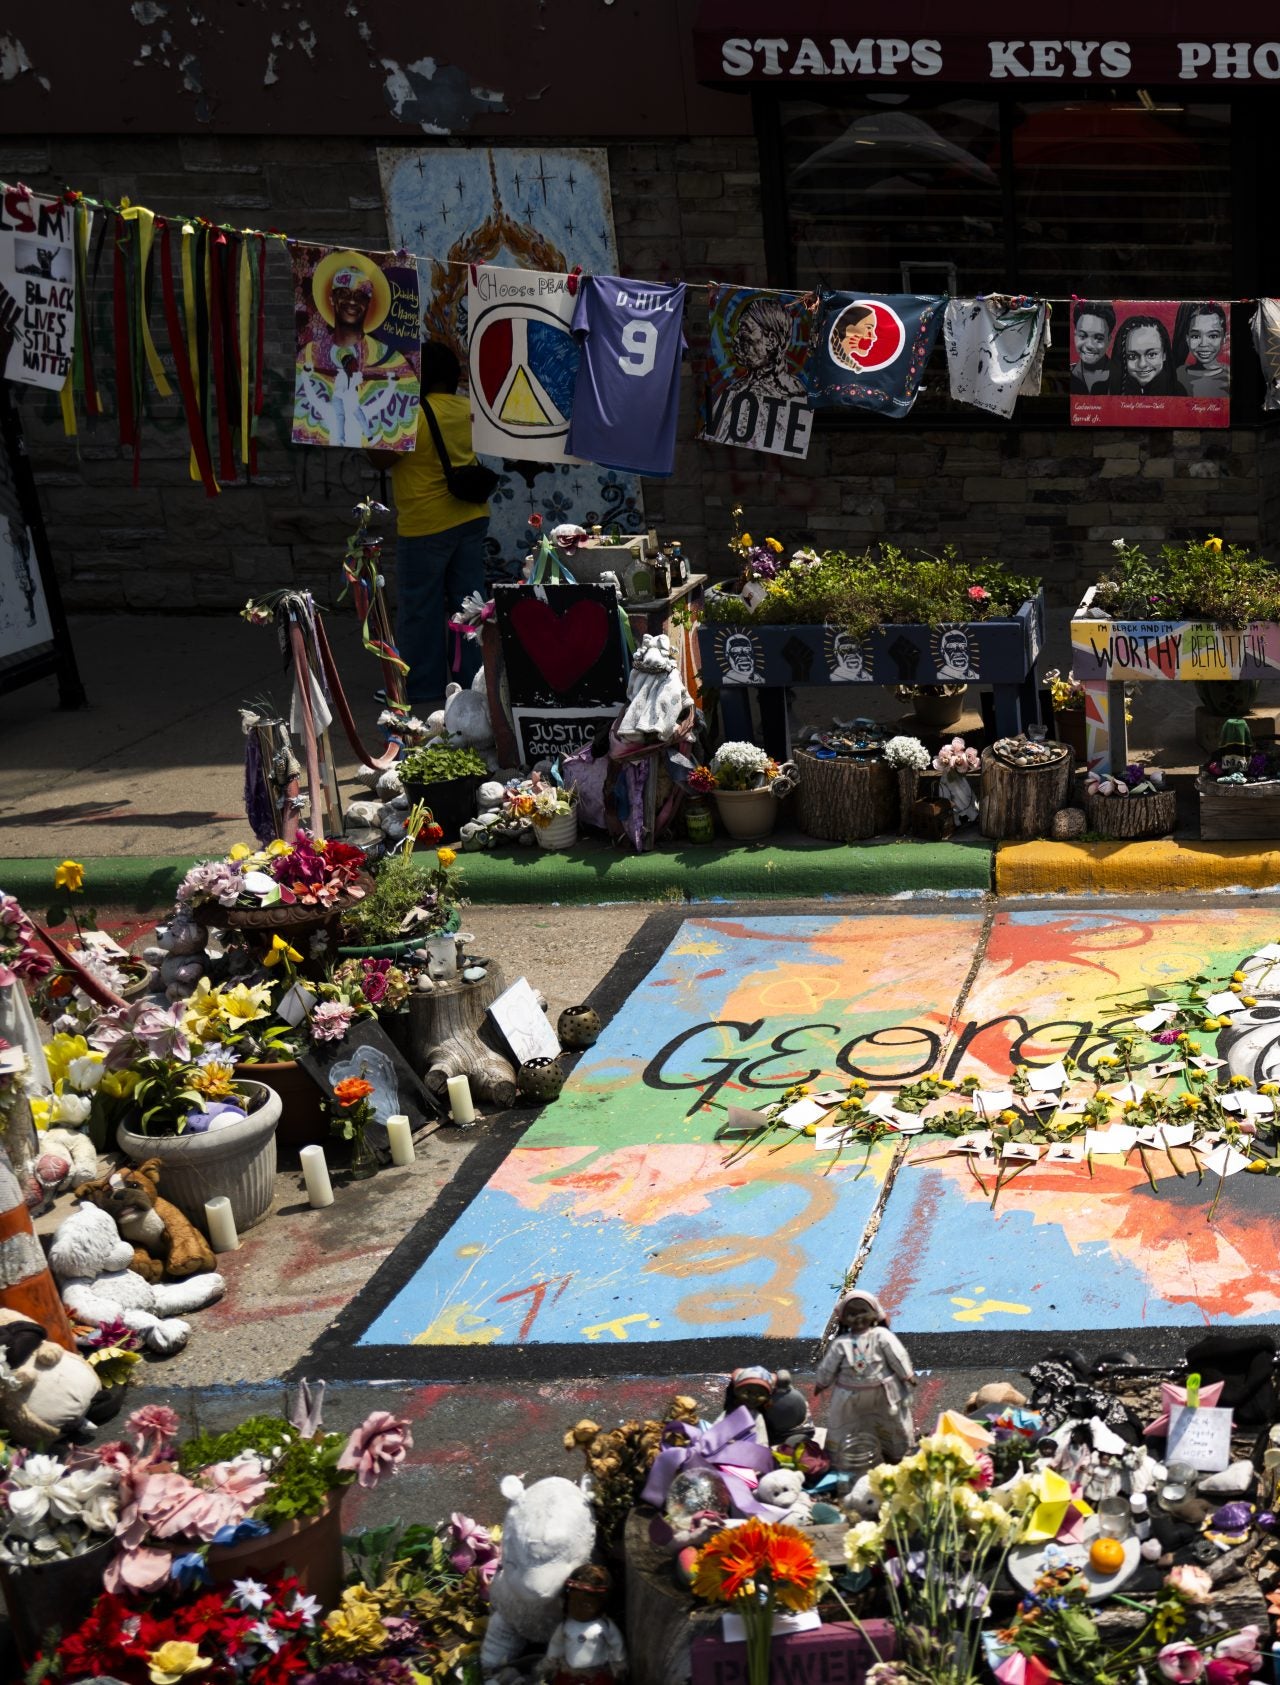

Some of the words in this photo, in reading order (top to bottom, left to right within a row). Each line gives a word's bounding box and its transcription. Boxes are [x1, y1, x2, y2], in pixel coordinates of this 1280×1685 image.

[721, 38, 943, 77] STAMPS
[987, 40, 1132, 78] KEYS
[25, 281, 74, 313] BLACK
[538, 277, 580, 297] PEA
[615, 290, 675, 313] D.HILL
[24, 307, 67, 339] LIVES
[23, 329, 67, 357] STILL
[618, 319, 659, 377] 9
[704, 389, 807, 455] VOTE
[1097, 624, 1108, 632] I'M
[1112, 624, 1138, 632] BLACK
[1141, 624, 1159, 632] AND
[1161, 624, 1173, 632] I'M
[1191, 624, 1203, 632] I'M
[1206, 624, 1230, 632] BLACK
[1090, 633, 1182, 669] WORTHY
[1191, 634, 1273, 669] BEAUTIFUL
[529, 723, 596, 741] JUSTIC
